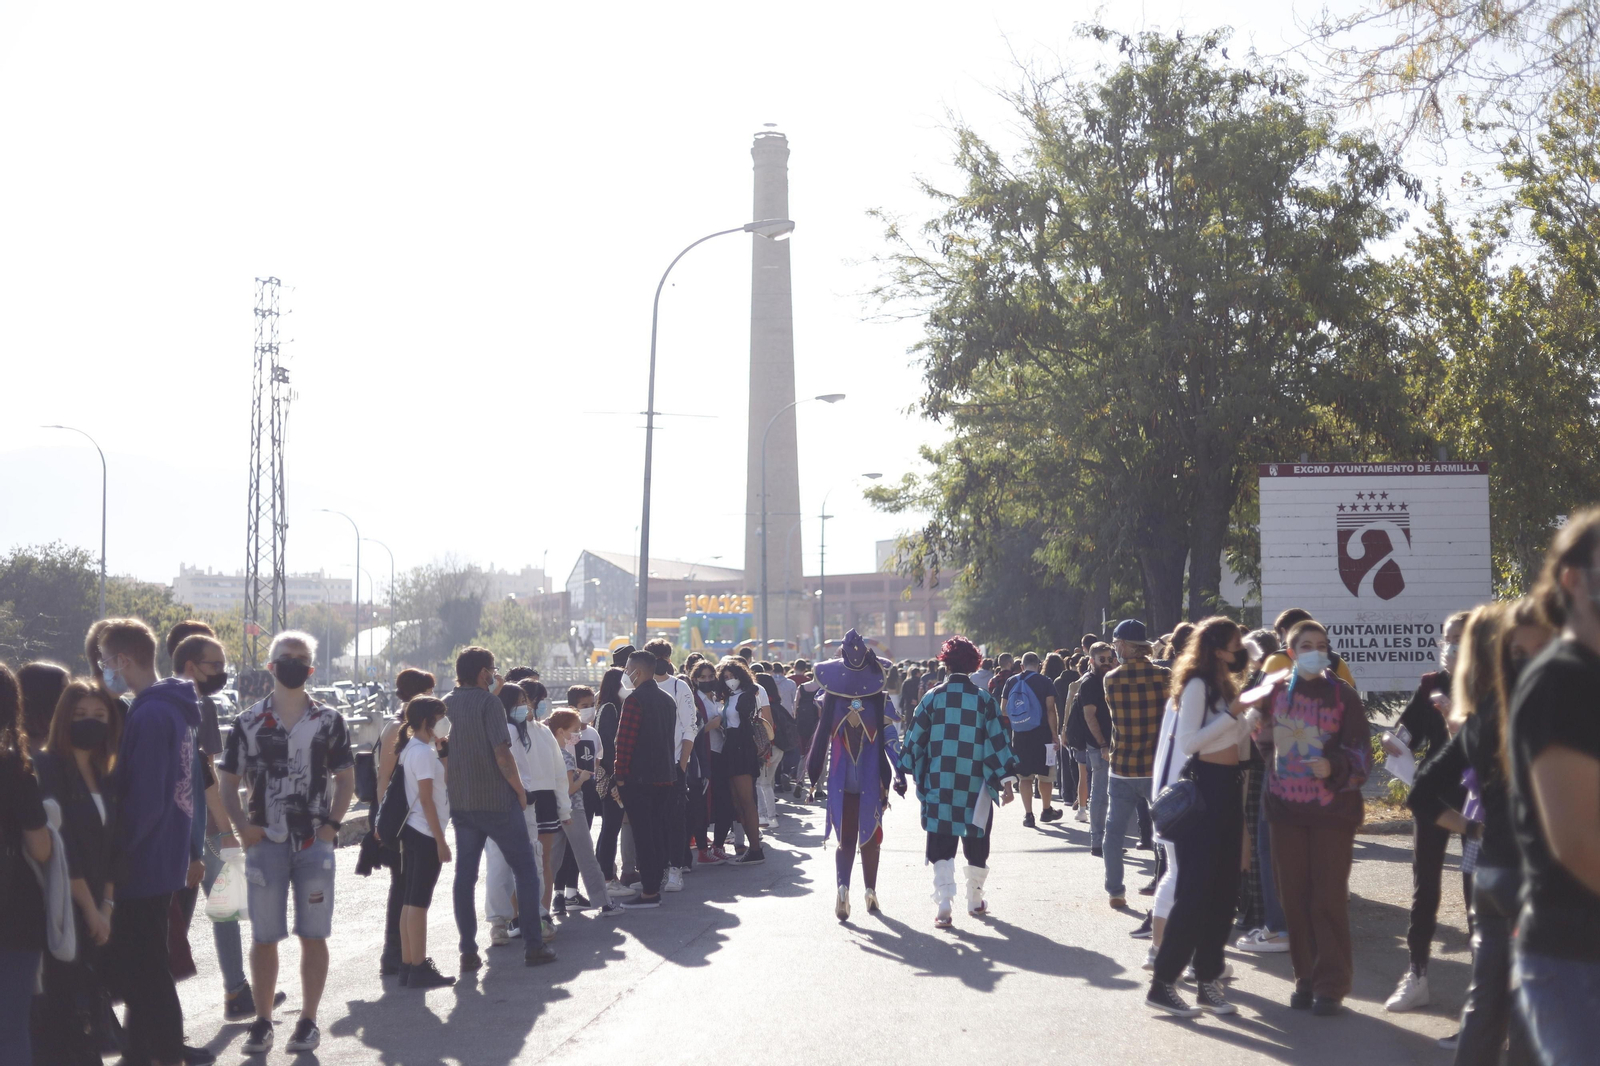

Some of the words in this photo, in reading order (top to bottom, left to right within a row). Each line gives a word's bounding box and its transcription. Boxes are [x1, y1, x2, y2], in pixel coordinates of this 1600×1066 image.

[1293, 465, 1330, 474] EXCMO
[1333, 464, 1414, 474] AYUNTAMIENTO
[1417, 464, 1431, 473] DE
[1434, 463, 1480, 473] ARMILLA
[1322, 624, 1435, 636] YUNTAMIENTO
[1384, 637, 1412, 648] LES
[1417, 637, 1438, 648] DA
[1340, 651, 1435, 662] BIENVENIDA
